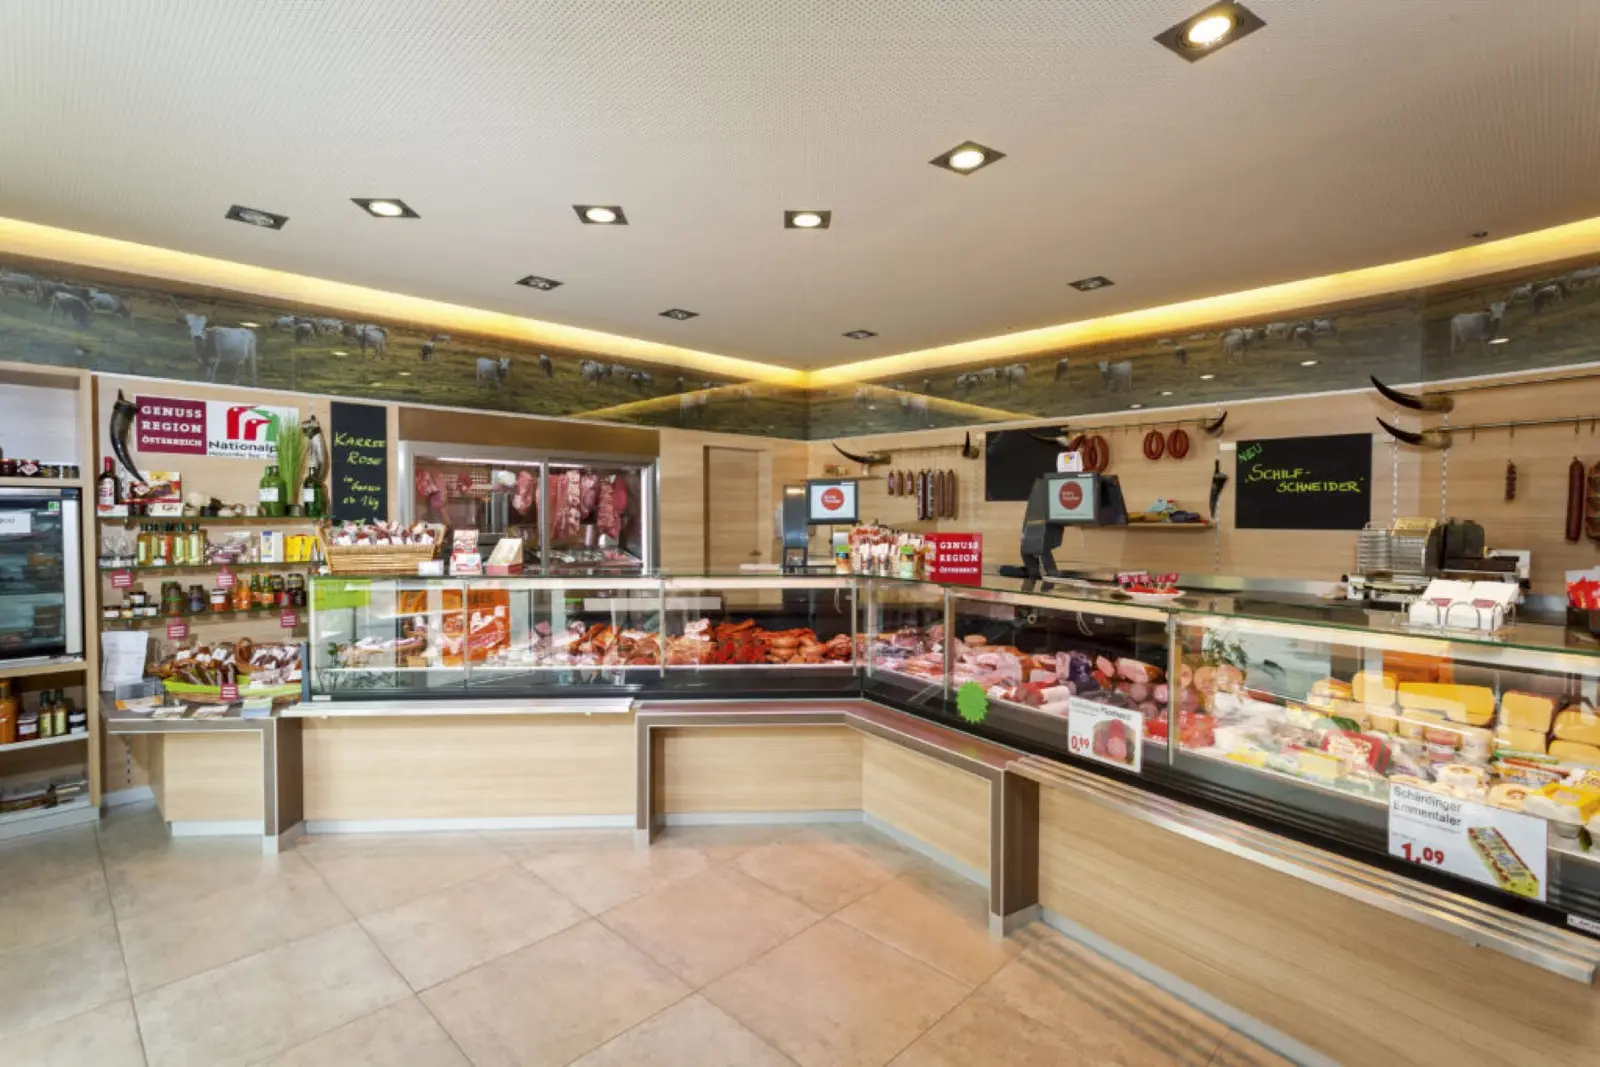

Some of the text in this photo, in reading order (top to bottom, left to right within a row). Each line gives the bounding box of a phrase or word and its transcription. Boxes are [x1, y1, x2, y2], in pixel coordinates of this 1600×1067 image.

[141, 405, 203, 418] GENUSS
[141, 420, 203, 433] REGION
[141, 435, 203, 447] ÖSTERREICH
[1238, 443, 1263, 462] NEU
[940, 541, 979, 550] GENUSS
[940, 554, 978, 562] REGION
[1393, 785, 1461, 813] Schärdinger
[1393, 801, 1462, 827] Emmentaler
